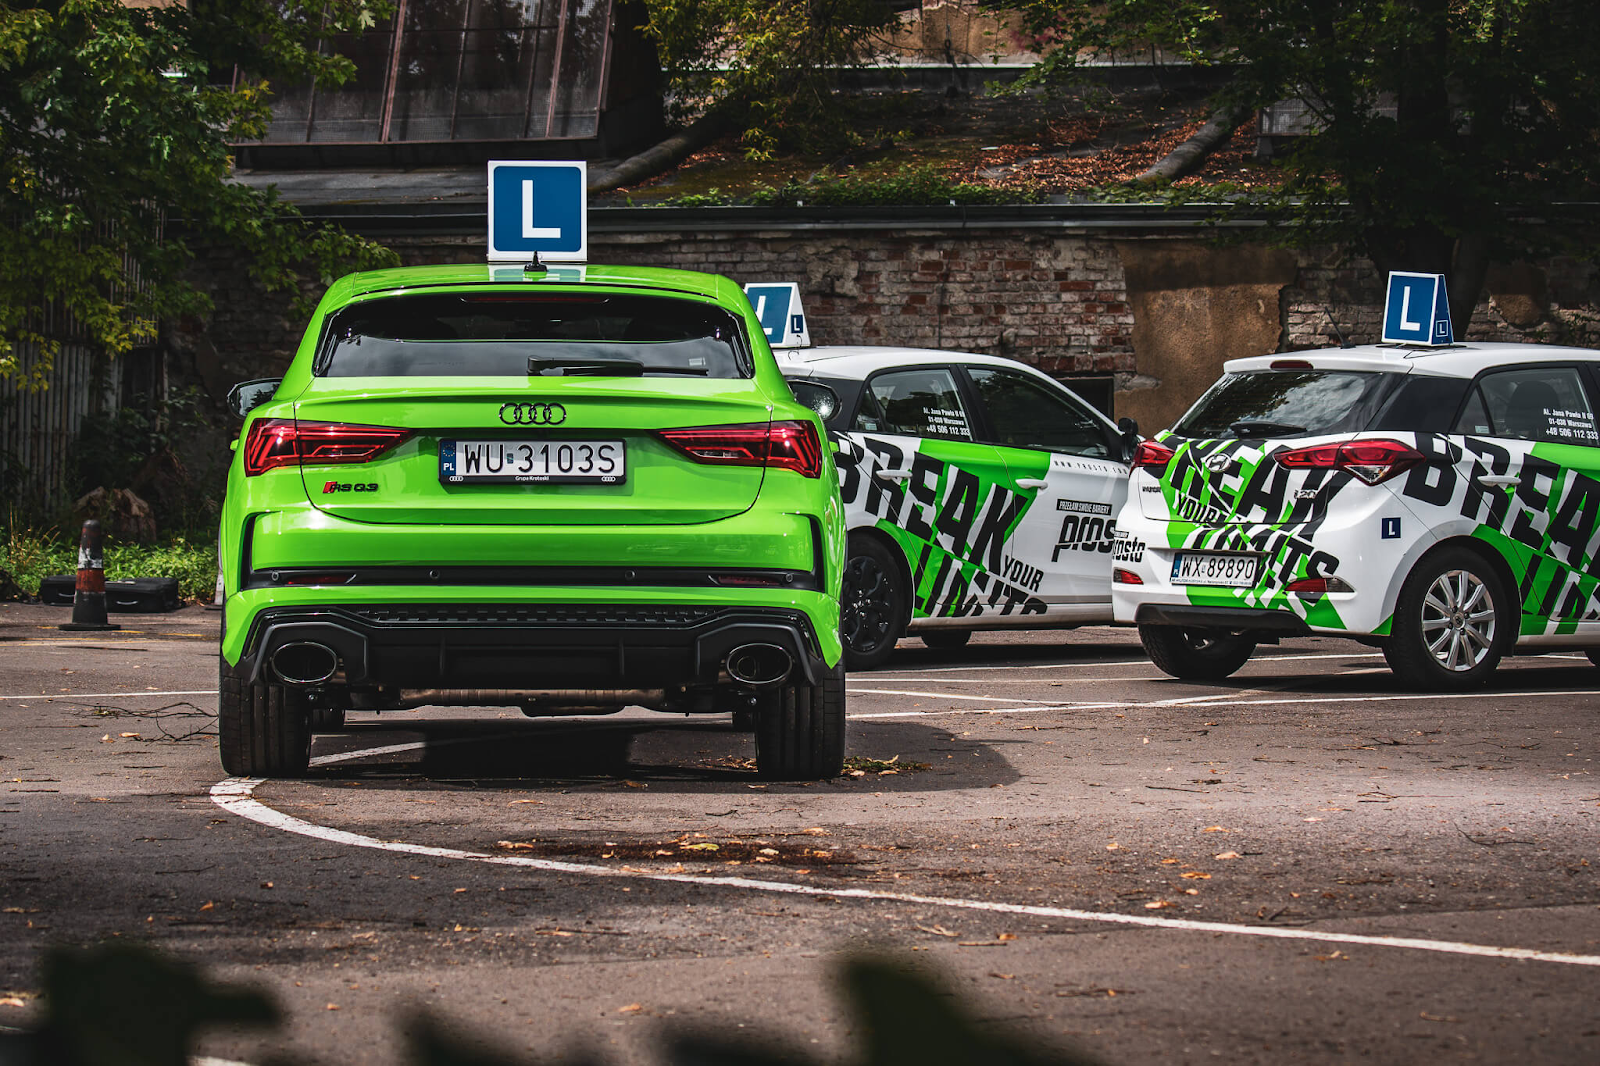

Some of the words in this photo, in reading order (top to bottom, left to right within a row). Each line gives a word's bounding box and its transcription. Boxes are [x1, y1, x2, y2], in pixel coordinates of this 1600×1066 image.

[522, 179, 561, 239] L
[1400, 286, 1420, 331] L
[794, 317, 801, 331] L
[1440, 323, 1446, 334] L
[937, 426, 948, 434] 506
[949, 427, 959, 435] 112
[1567, 419, 1592, 428] Warszawa
[1546, 427, 1558, 436] +48
[1559, 428, 1572, 437] 506
[1573, 429, 1585, 439] 112
[1586, 431, 1599, 440] 333
[464, 444, 504, 474] WU
[517, 444, 616, 474] 3103S
[443, 463, 454, 471] PL
[354, 483, 379, 493] Q3
[1403, 432, 1600, 570] BREA
[1389, 521, 1396, 536] L
[1112, 537, 1146, 563] rosto
[1002, 555, 1044, 592] YOUR
[1181, 556, 1204, 577] WX
[1207, 557, 1255, 579] 89890
